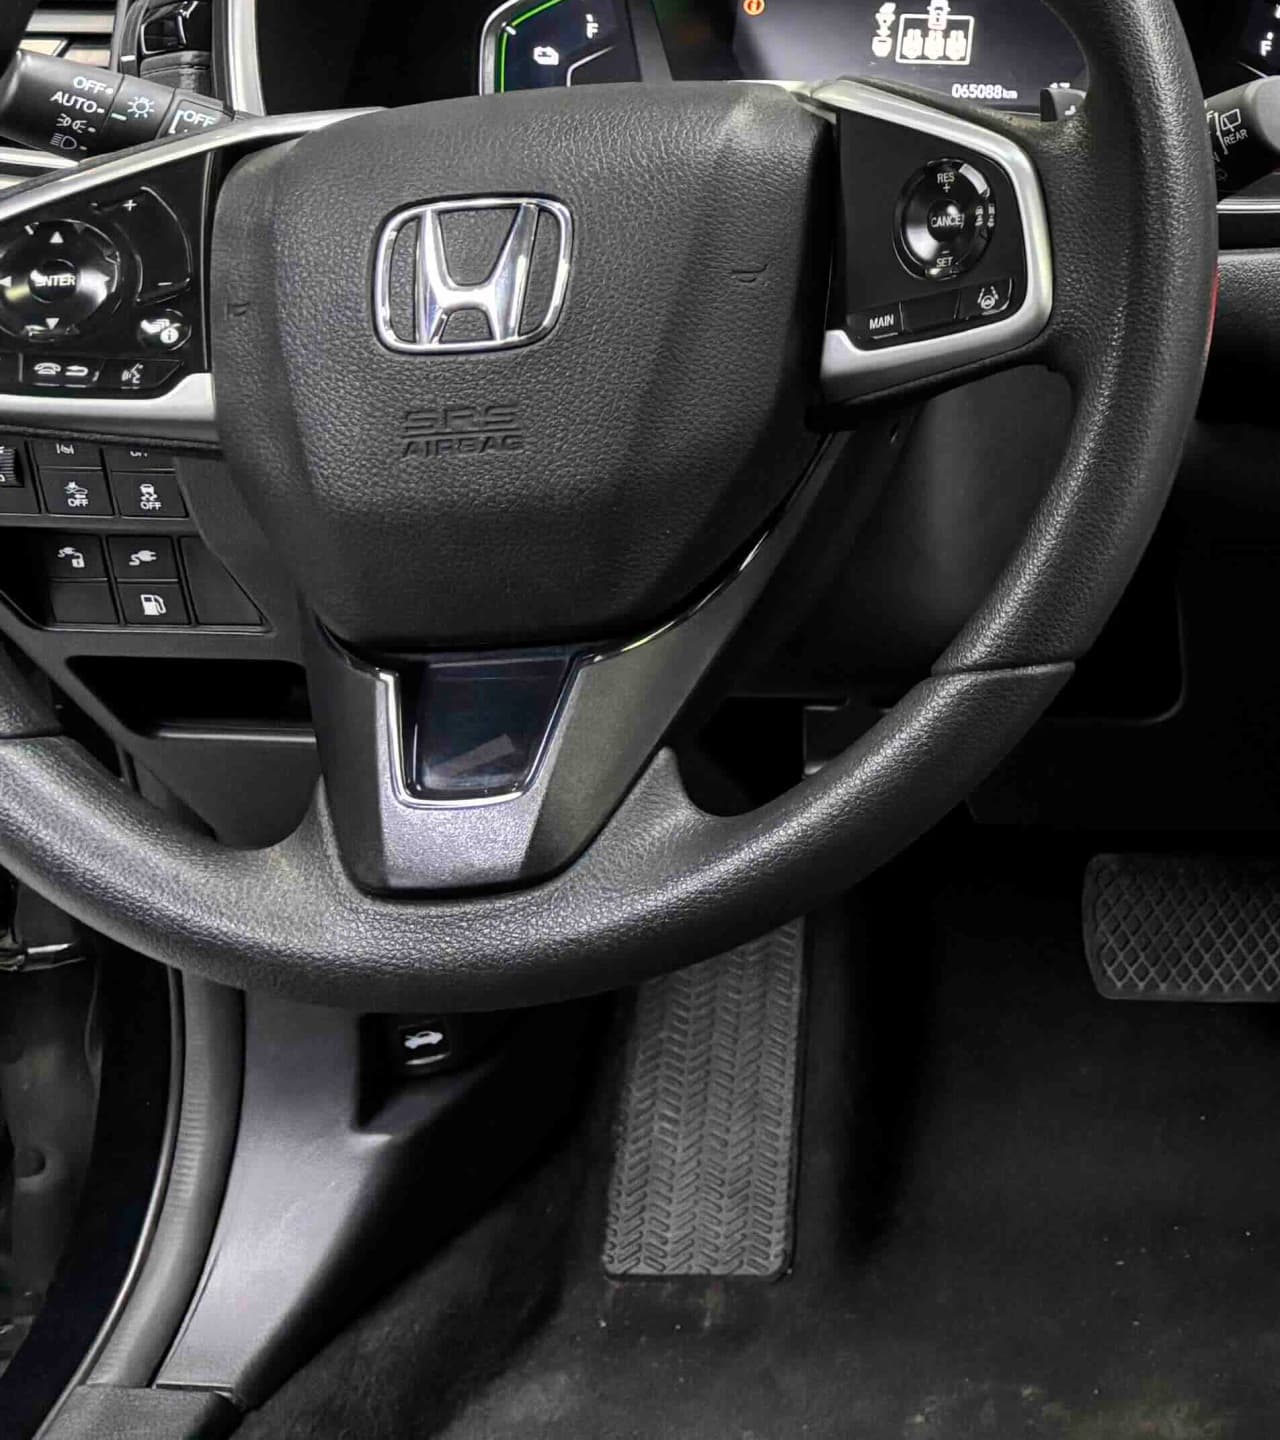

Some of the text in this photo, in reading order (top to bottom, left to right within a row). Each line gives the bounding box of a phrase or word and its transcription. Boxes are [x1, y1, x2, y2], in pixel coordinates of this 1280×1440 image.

[73, 76, 107, 94] OFF
[50, 90, 98, 114] AUTO
[184, 110, 216, 128] OFF
[1223, 128, 1249, 146] REAR
[937, 172, 955, 184] RES
[936, 257, 954, 268] SET
[869, 314, 895, 330] MAIN
[67, 498, 89, 507] OFF
[140, 501, 162, 510] OFF
